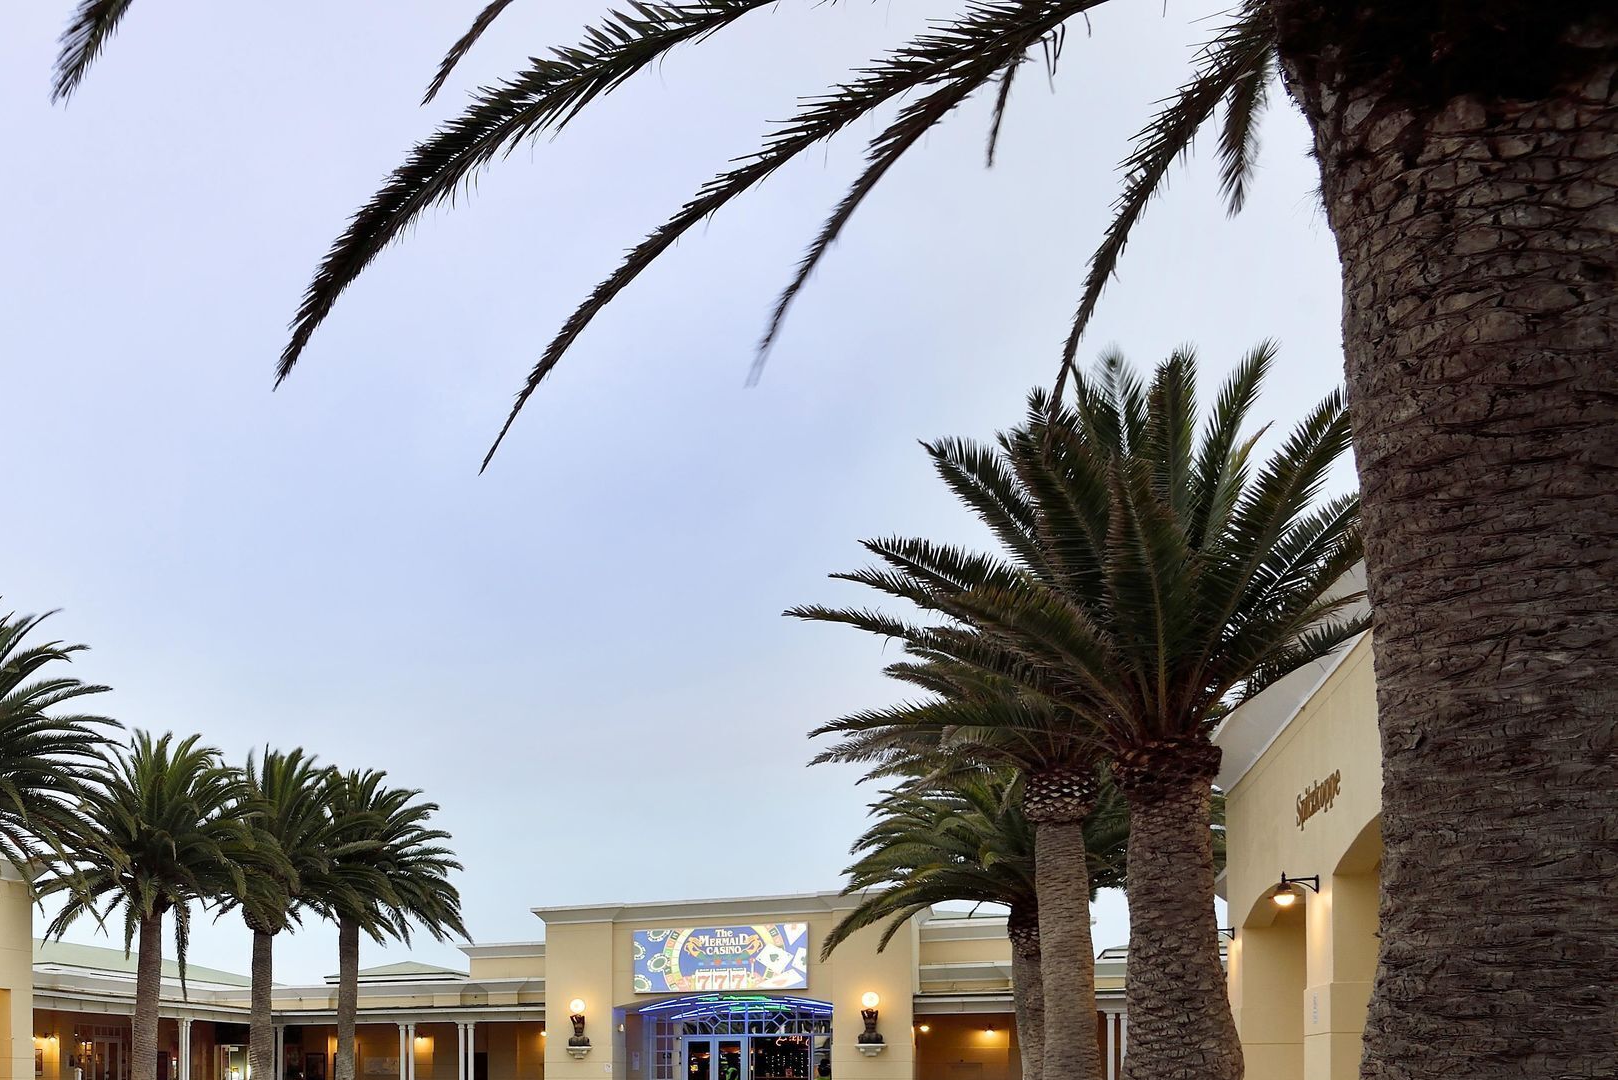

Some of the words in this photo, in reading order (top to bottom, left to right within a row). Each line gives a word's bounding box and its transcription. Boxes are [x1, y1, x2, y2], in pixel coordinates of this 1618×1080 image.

[1296, 768, 1341, 832] Spitzkoppe
[715, 929, 733, 937] The
[706, 946, 742, 955] CASINO
